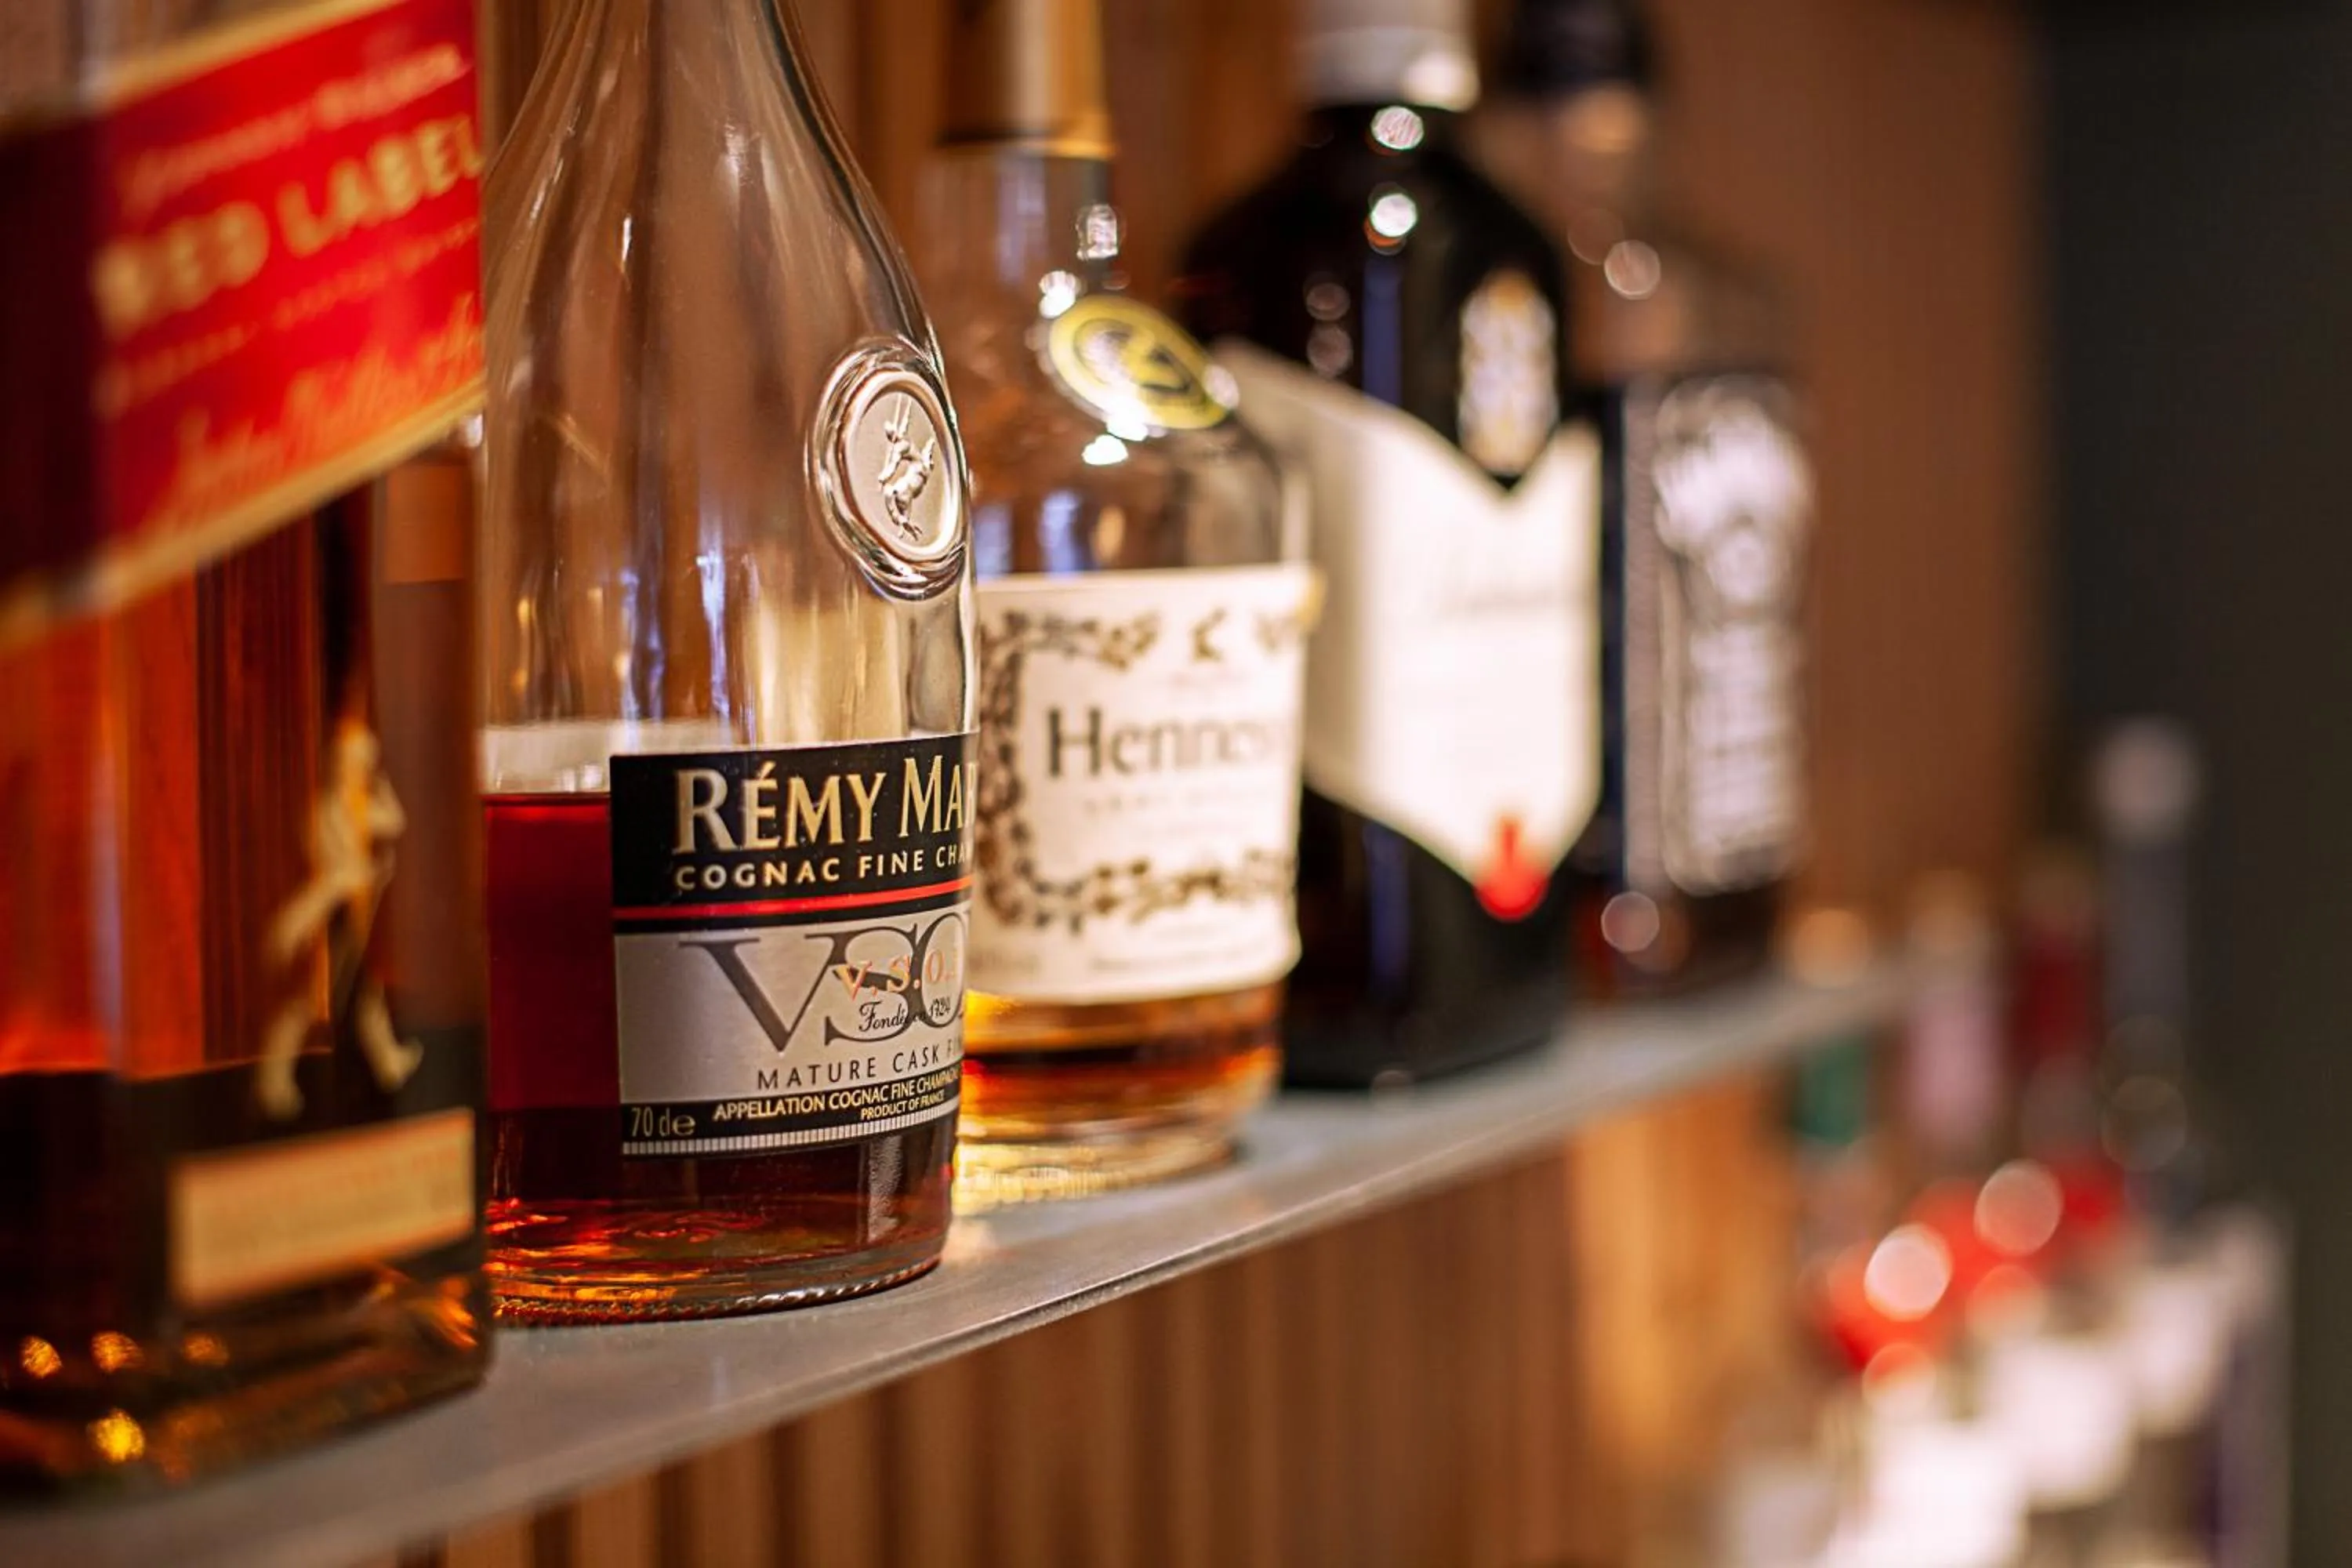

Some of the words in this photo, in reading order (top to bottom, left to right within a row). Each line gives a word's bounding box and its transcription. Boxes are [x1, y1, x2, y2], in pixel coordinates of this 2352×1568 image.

[274, 112, 481, 259] LABEL
[671, 760, 886, 855] RÉMY
[674, 858, 840, 891] COGNAC
[859, 848, 924, 878] FINE
[757, 1057, 877, 1090] MATURE
[892, 1044, 940, 1073] CASK
[630, 1106, 654, 1137] 70
[713, 1090, 826, 1122] APPELLATION
[829, 1084, 889, 1109] COGNAC
[891, 1079, 916, 1099] FINE
[861, 1100, 907, 1120] PRODUCT
[909, 1098, 920, 1110] OF
